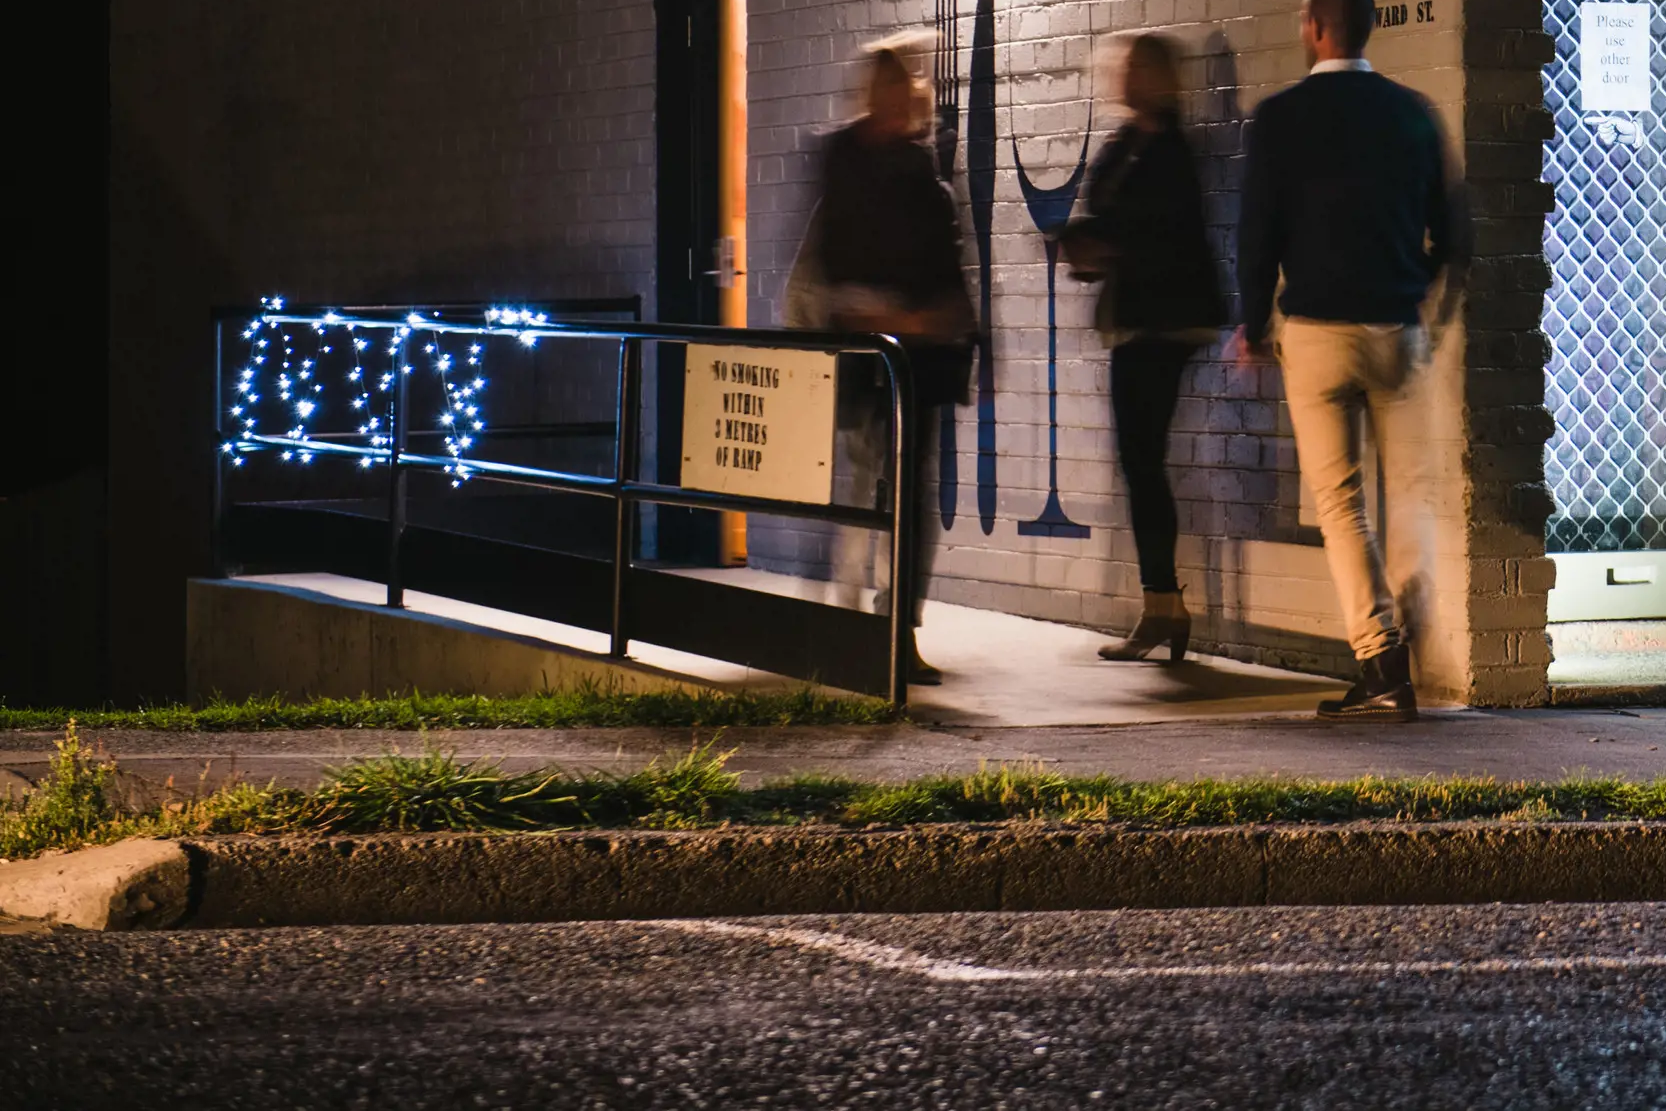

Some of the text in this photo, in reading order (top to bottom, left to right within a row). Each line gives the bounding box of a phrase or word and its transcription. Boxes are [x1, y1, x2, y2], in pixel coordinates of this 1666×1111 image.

[1416, 0, 1434, 24] ST.
[1596, 15, 1635, 28] Please
[1605, 37, 1625, 47] use
[1600, 53, 1631, 66] other
[1602, 71, 1630, 84] door
[713, 360, 780, 389] NO SMOKING
[723, 392, 765, 418] WITHIN
[715, 418, 768, 445] 3 METRES
[716, 446, 762, 472] OF RAMP
